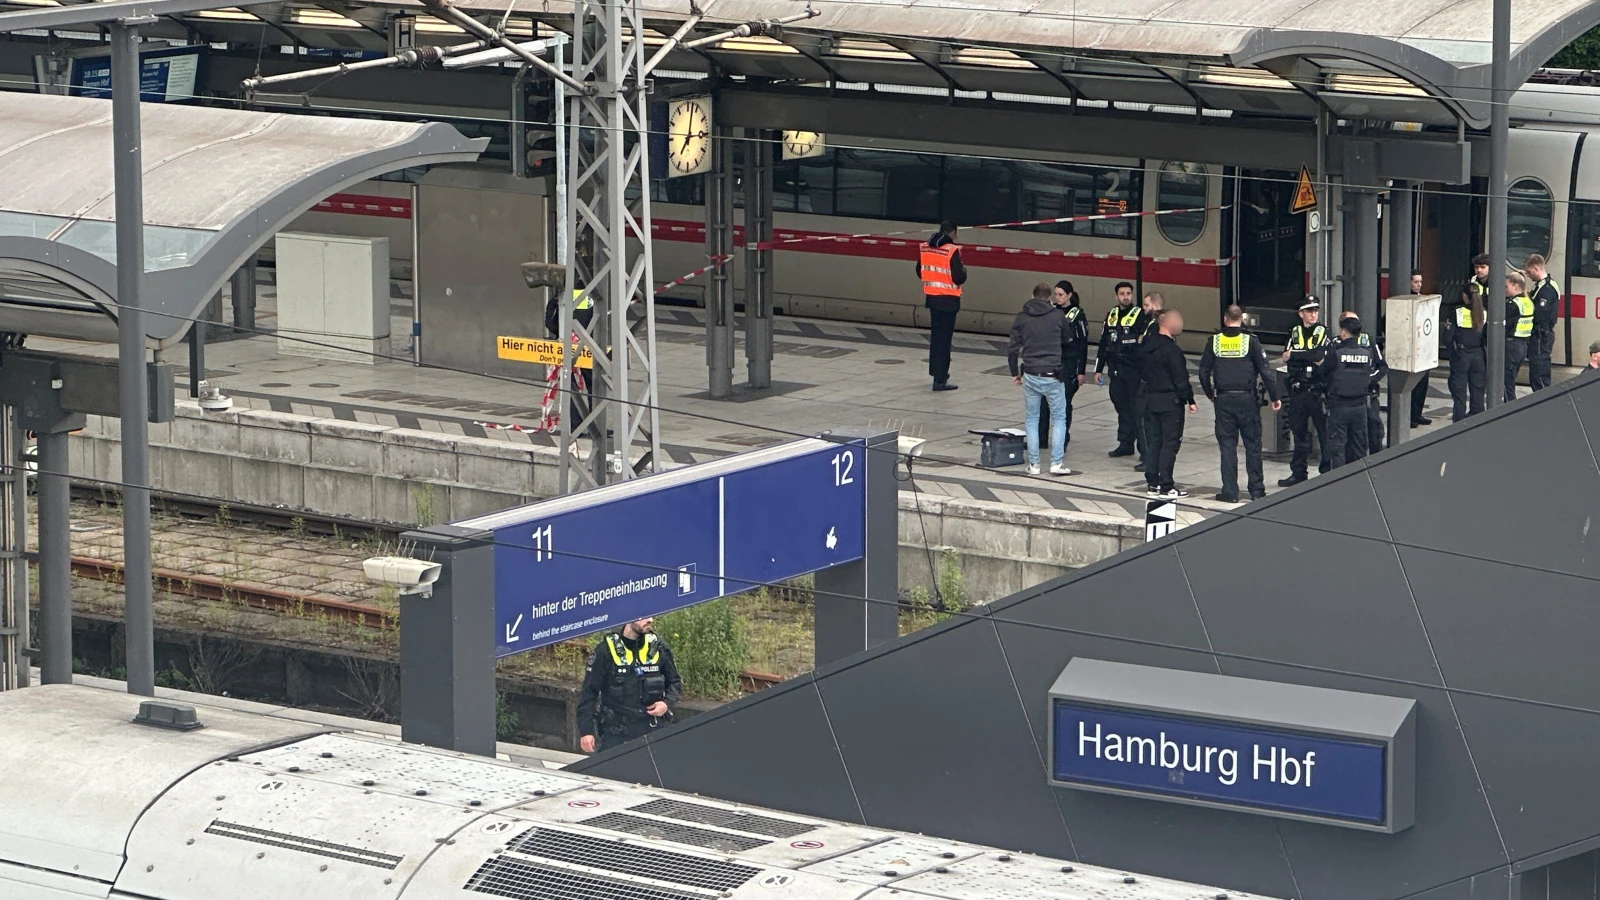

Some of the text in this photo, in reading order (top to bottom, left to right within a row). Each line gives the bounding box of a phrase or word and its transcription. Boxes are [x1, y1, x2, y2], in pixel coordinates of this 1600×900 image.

[1102, 171, 1120, 197] 2
[502, 338, 525, 351] Hier
[527, 341, 553, 354] nicht
[1341, 354, 1369, 363] POLIZEI
[831, 450, 854, 487] 12
[532, 524, 552, 562] 11
[532, 573, 668, 619] hinter der Treppeneinhausung
[532, 614, 609, 641] behind the staircase enclosure
[1078, 720, 1316, 787] Hamburg Hbf
